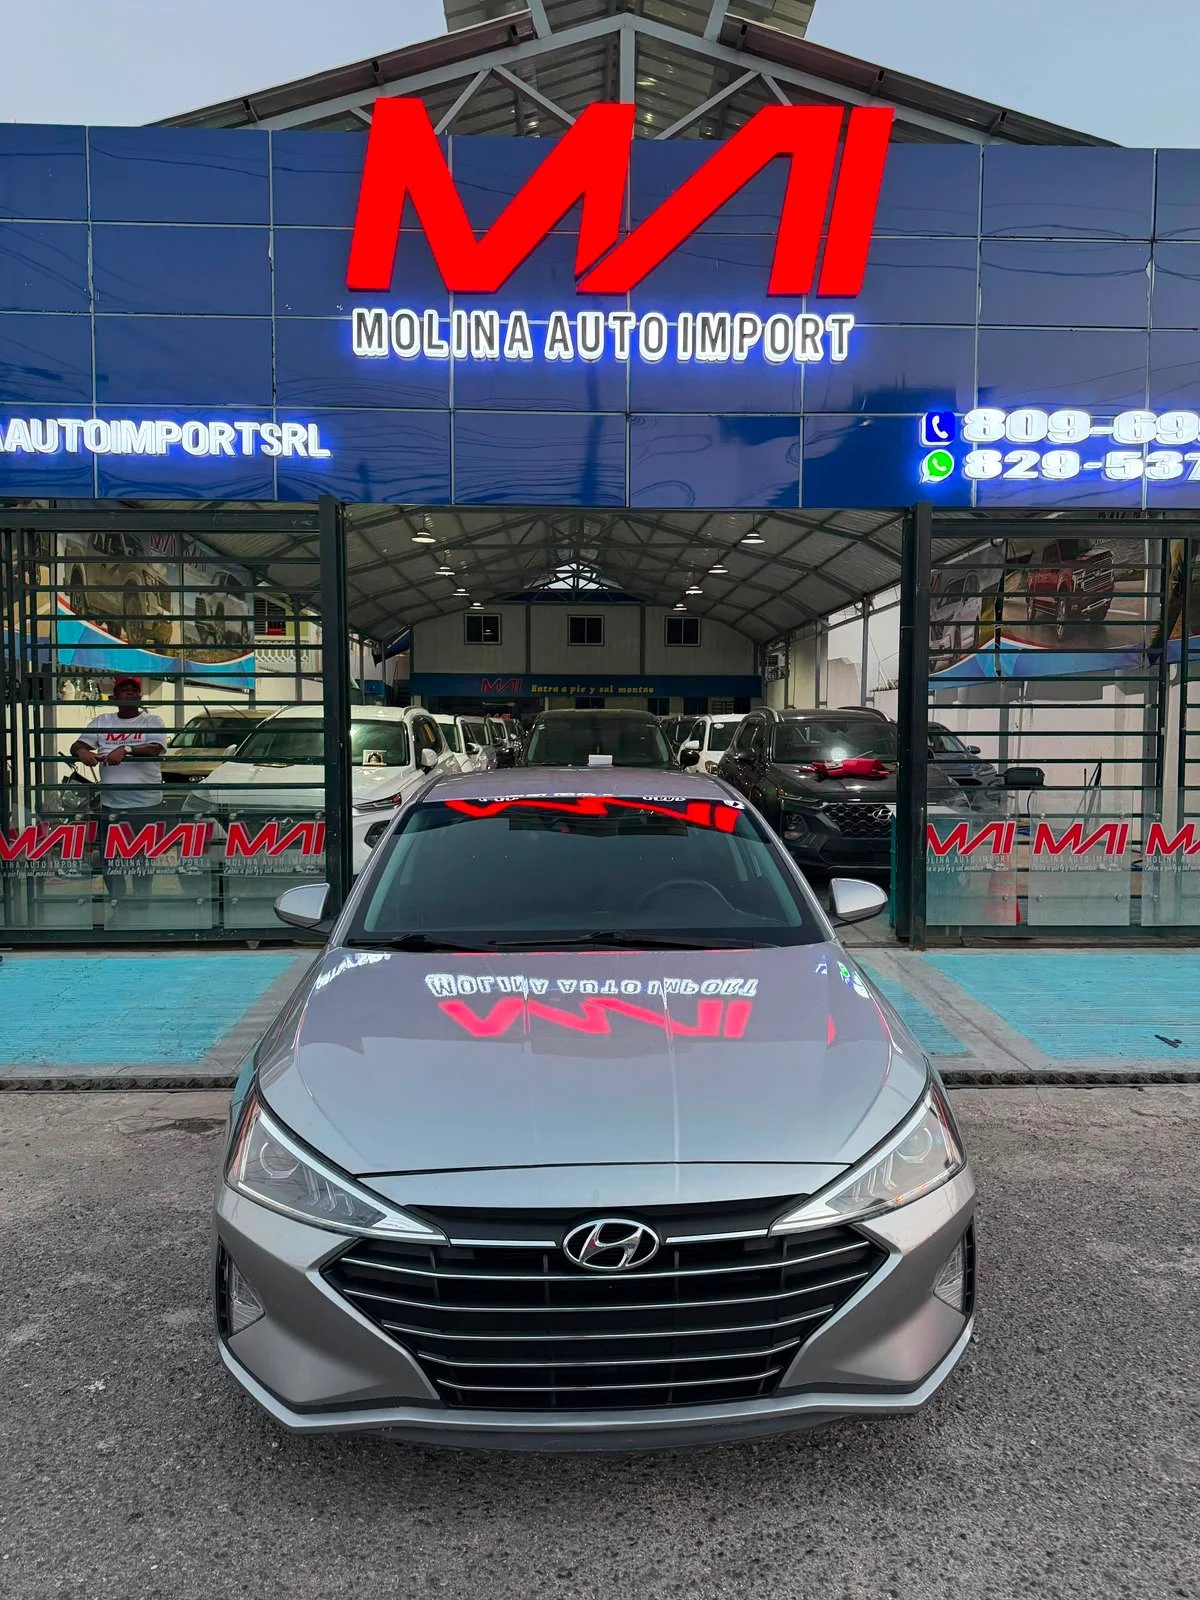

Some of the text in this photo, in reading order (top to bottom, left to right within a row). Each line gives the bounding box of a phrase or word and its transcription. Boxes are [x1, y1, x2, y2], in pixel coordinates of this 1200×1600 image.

[345, 97, 895, 299] MAI
[352, 308, 855, 361] MOLINA AUTO IMPORT
[0, 418, 332, 457] AUTOIMPORTSRL
[964, 408, 1200, 444] 809-69
[481, 678, 522, 692] MAI
[104, 823, 207, 859] MAI
[225, 821, 325, 857] MAI
[927, 821, 1016, 857] MAI
[1032, 822, 1129, 856] MAI
